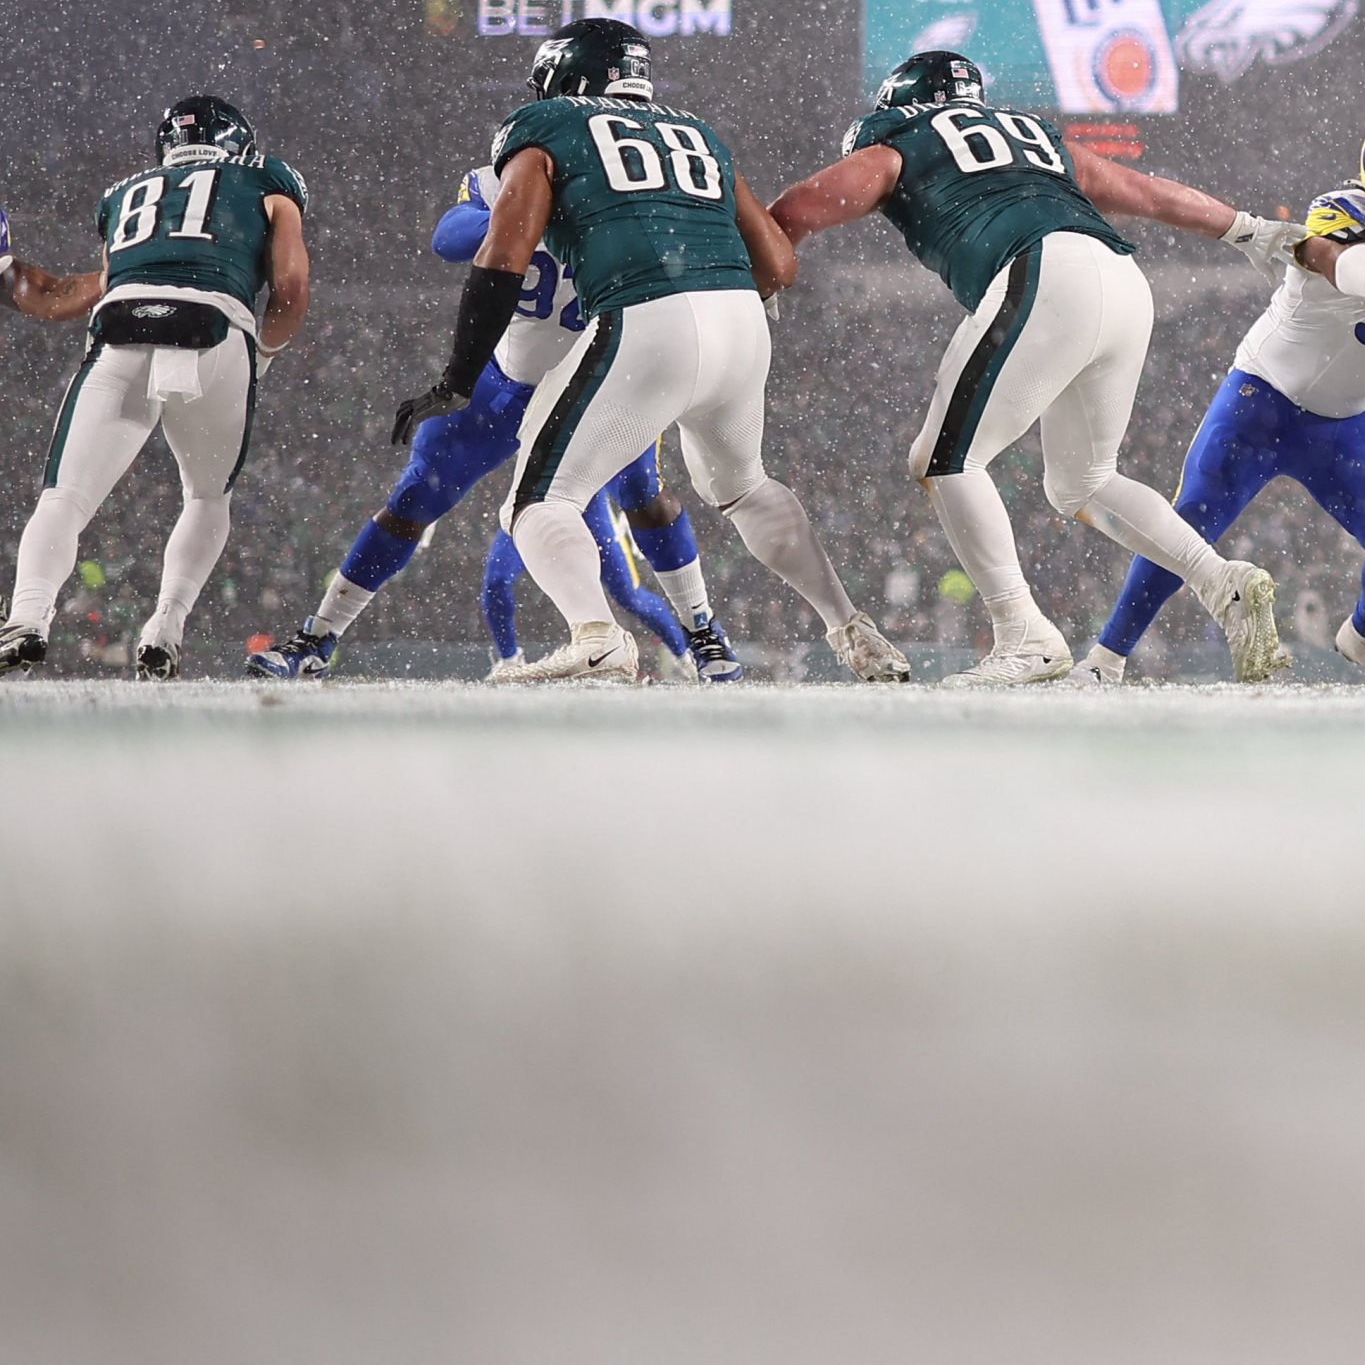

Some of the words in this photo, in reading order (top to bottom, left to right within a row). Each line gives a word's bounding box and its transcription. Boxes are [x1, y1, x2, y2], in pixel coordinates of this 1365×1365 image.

[171, 149, 198, 160] CHOOSE
[199, 148, 218, 157] LOVE
[587, 113, 723, 202] 68
[930, 108, 1066, 174] 69
[109, 167, 220, 254] 81
